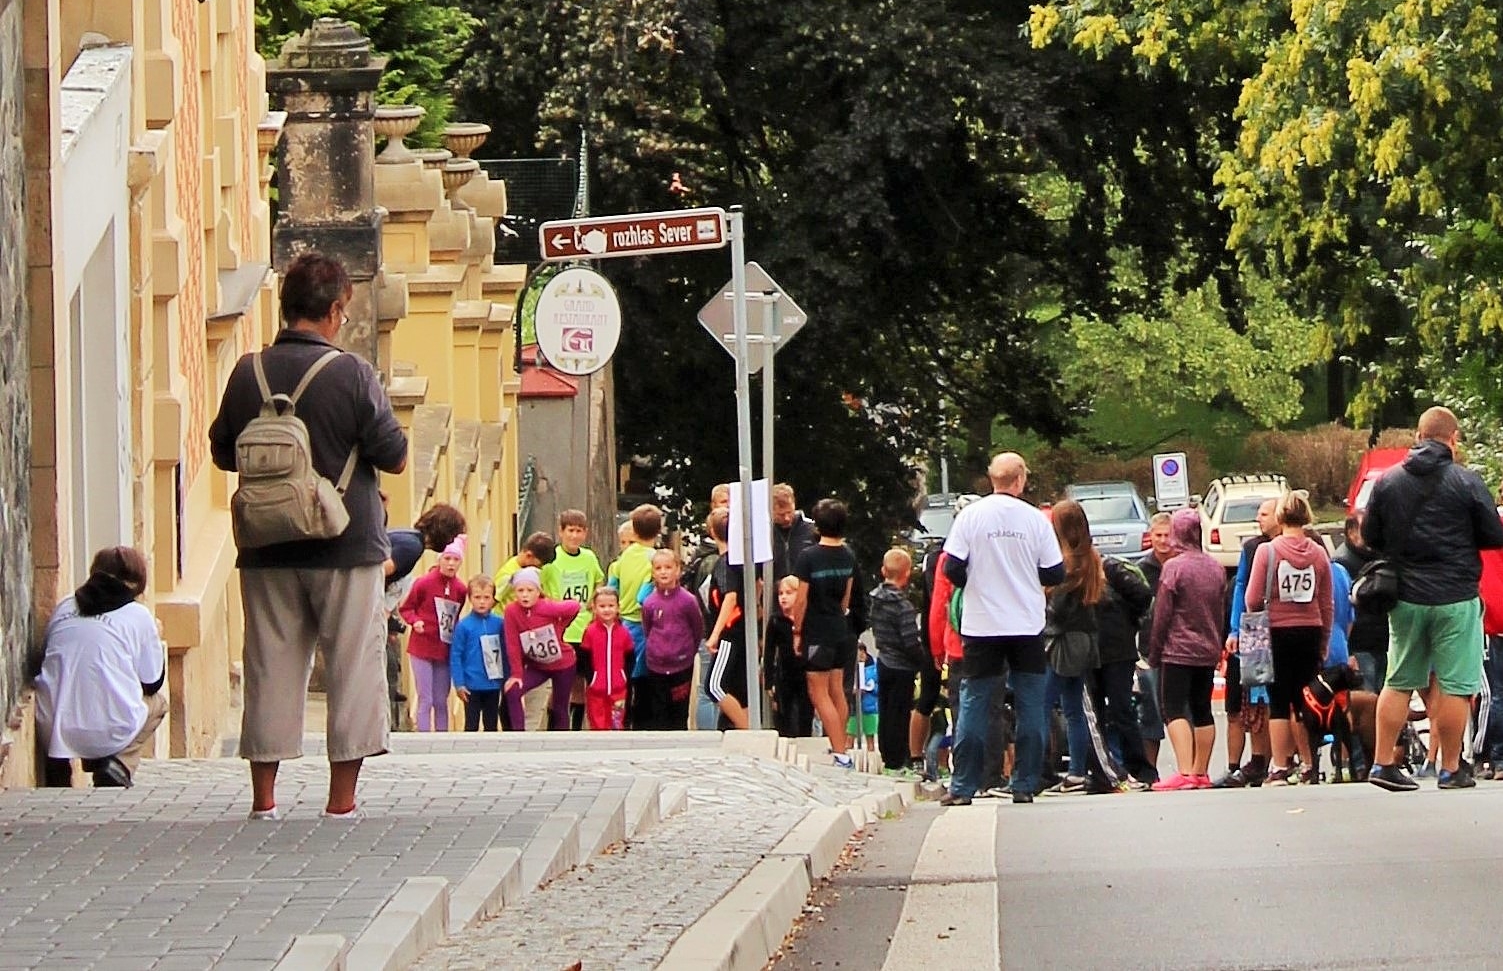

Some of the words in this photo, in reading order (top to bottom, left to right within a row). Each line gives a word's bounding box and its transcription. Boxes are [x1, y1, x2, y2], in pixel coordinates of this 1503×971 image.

[613, 225, 655, 248] rozhlas
[658, 222, 692, 244] Sever
[1281, 573, 1312, 593] 475
[563, 584, 589, 603] 450
[527, 638, 559, 659] 436
